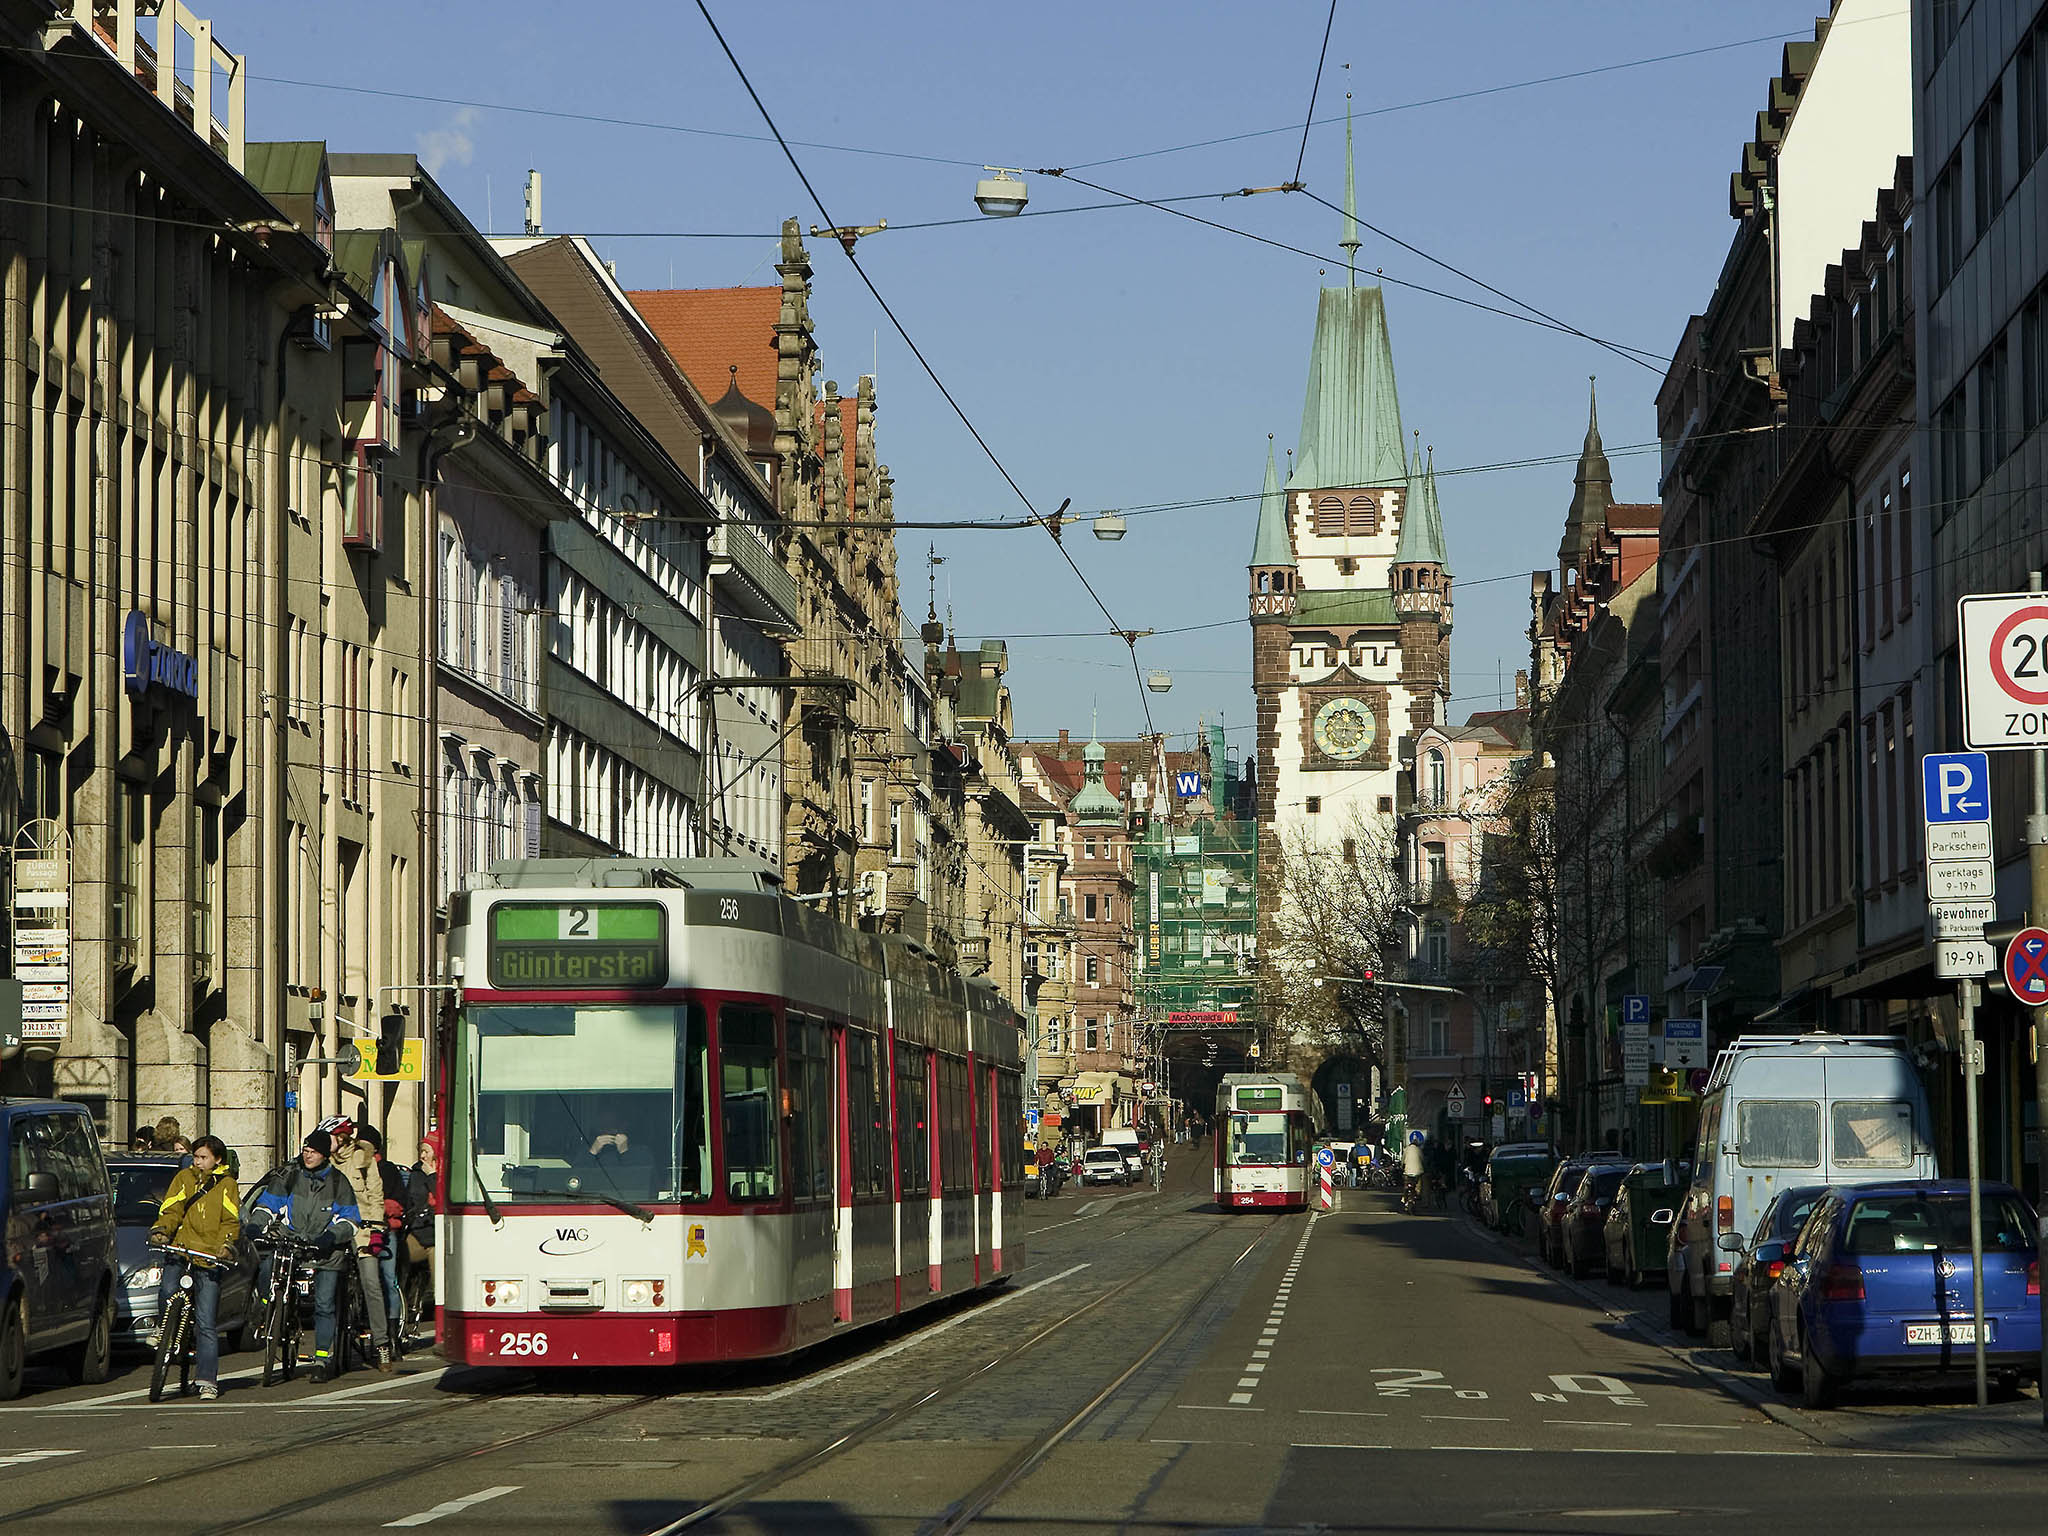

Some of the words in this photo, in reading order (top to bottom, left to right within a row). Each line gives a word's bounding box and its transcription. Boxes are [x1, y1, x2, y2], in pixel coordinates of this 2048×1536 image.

[2012, 634, 2048, 678] 2
[1177, 774, 1198, 794] W
[1939, 763, 1973, 814] P
[1951, 829, 1967, 839] mit
[1932, 841, 1987, 852] Parkschein
[1937, 867, 1984, 879] werktags
[720, 899, 739, 920] 256
[1937, 906, 1990, 920] Bewohner
[569, 906, 589, 936] 2
[503, 951, 656, 979] Günterstal
[1171, 1013, 1222, 1022] McDonald's
[1630, 1000, 1643, 1020] P
[1511, 1092, 1521, 1106] P
[556, 1228, 589, 1242] VAG
[500, 1332, 548, 1356] 256
